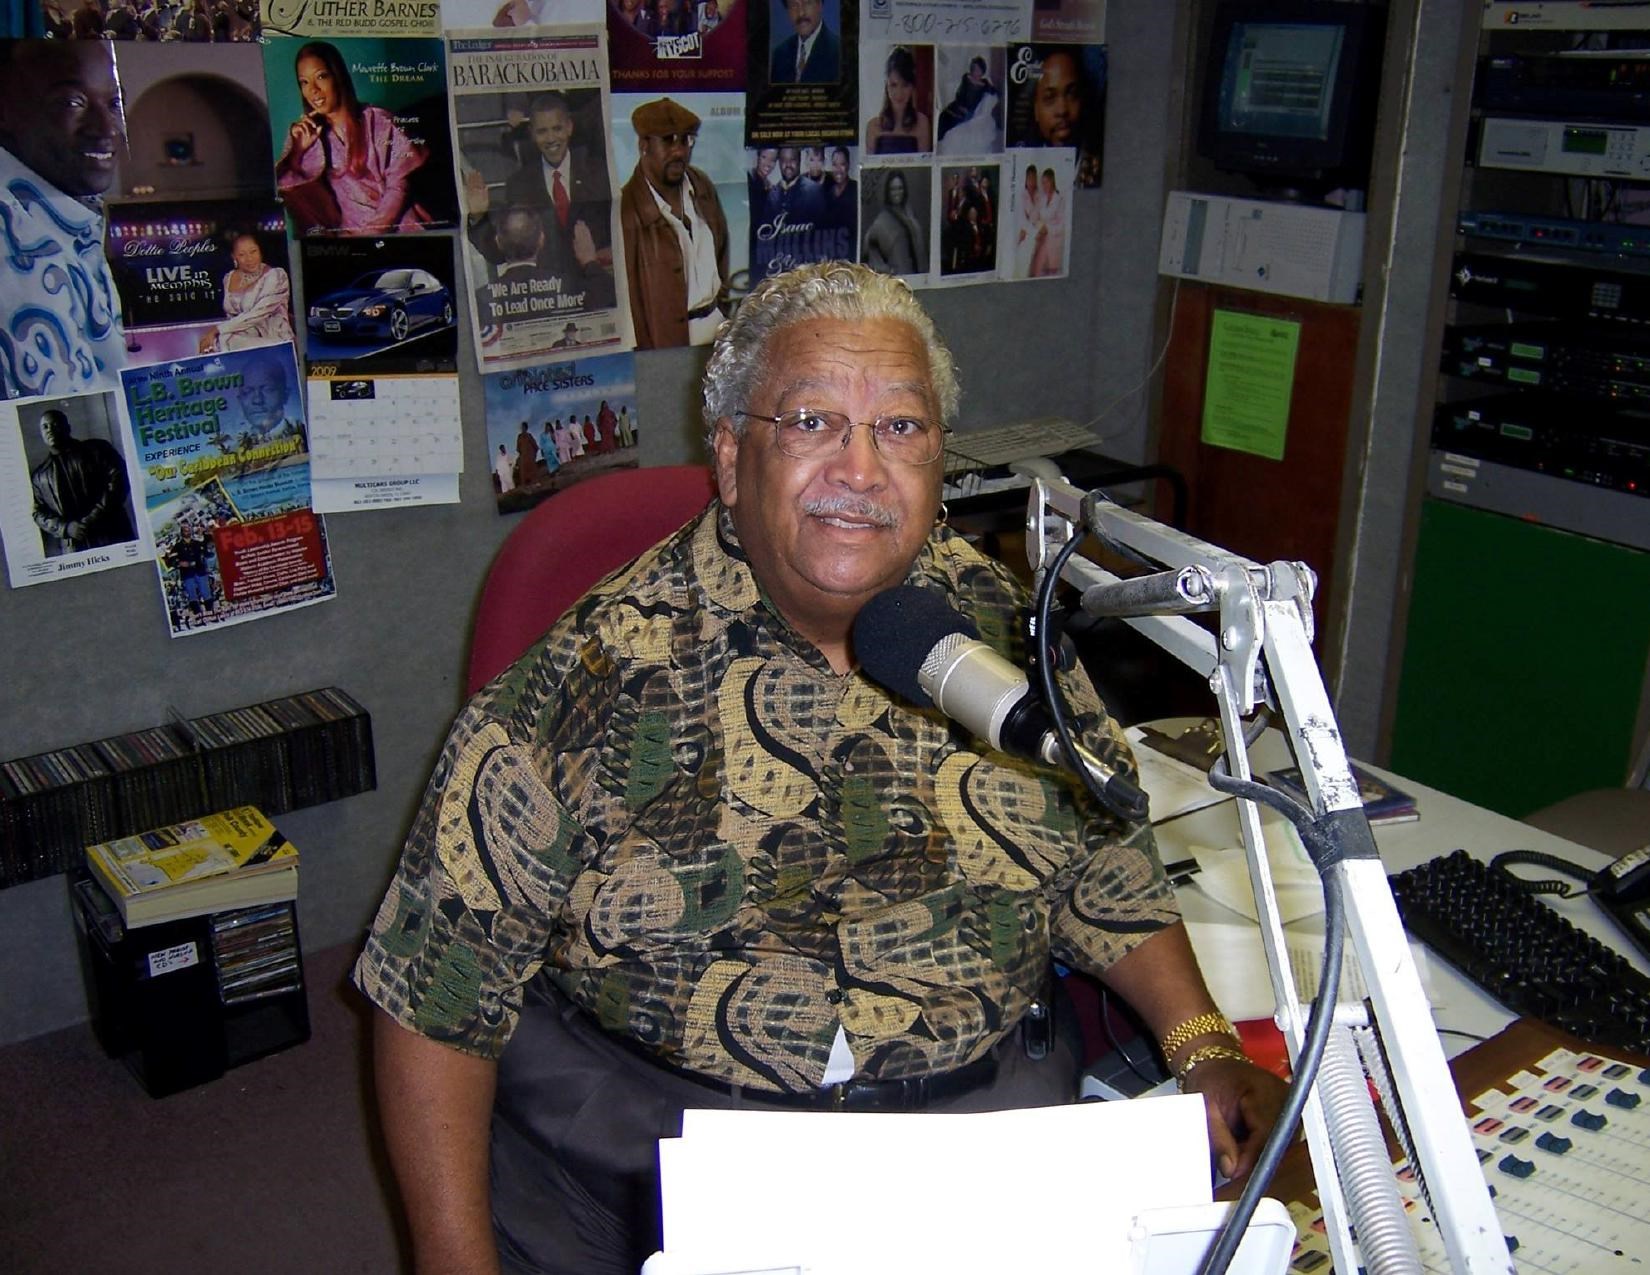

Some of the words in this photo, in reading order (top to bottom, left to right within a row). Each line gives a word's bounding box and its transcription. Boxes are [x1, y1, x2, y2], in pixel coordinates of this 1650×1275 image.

[373, 0, 438, 17] BARNES
[318, 17, 333, 26] THE
[336, 18, 351, 26] RED
[379, 18, 408, 27] GOSPEL
[392, 73, 424, 82] DREAM
[453, 62, 529, 87] BARACK
[531, 59, 600, 84] OBAMA
[613, 70, 650, 80] THANKS
[652, 70, 669, 79] FOR
[672, 70, 696, 79] YOUR
[698, 69, 736, 79] SUPPORT
[146, 265, 192, 284] LIVE
[511, 281, 528, 296] Are
[529, 276, 562, 293] Ready
[489, 302, 504, 317] To
[505, 298, 528, 315] Lead
[530, 297, 556, 311] Once
[175, 364, 205, 377] Annual
[311, 366, 337, 377] 2009
[176, 373, 245, 398] Brown
[552, 375, 595, 391] SISTERS
[136, 396, 228, 428] Heritage
[139, 413, 220, 447] Festival
[144, 443, 202, 463] EXPERIENCE
[219, 527, 266, 552] Feb.
[57, 560, 86, 573] Jimmy
